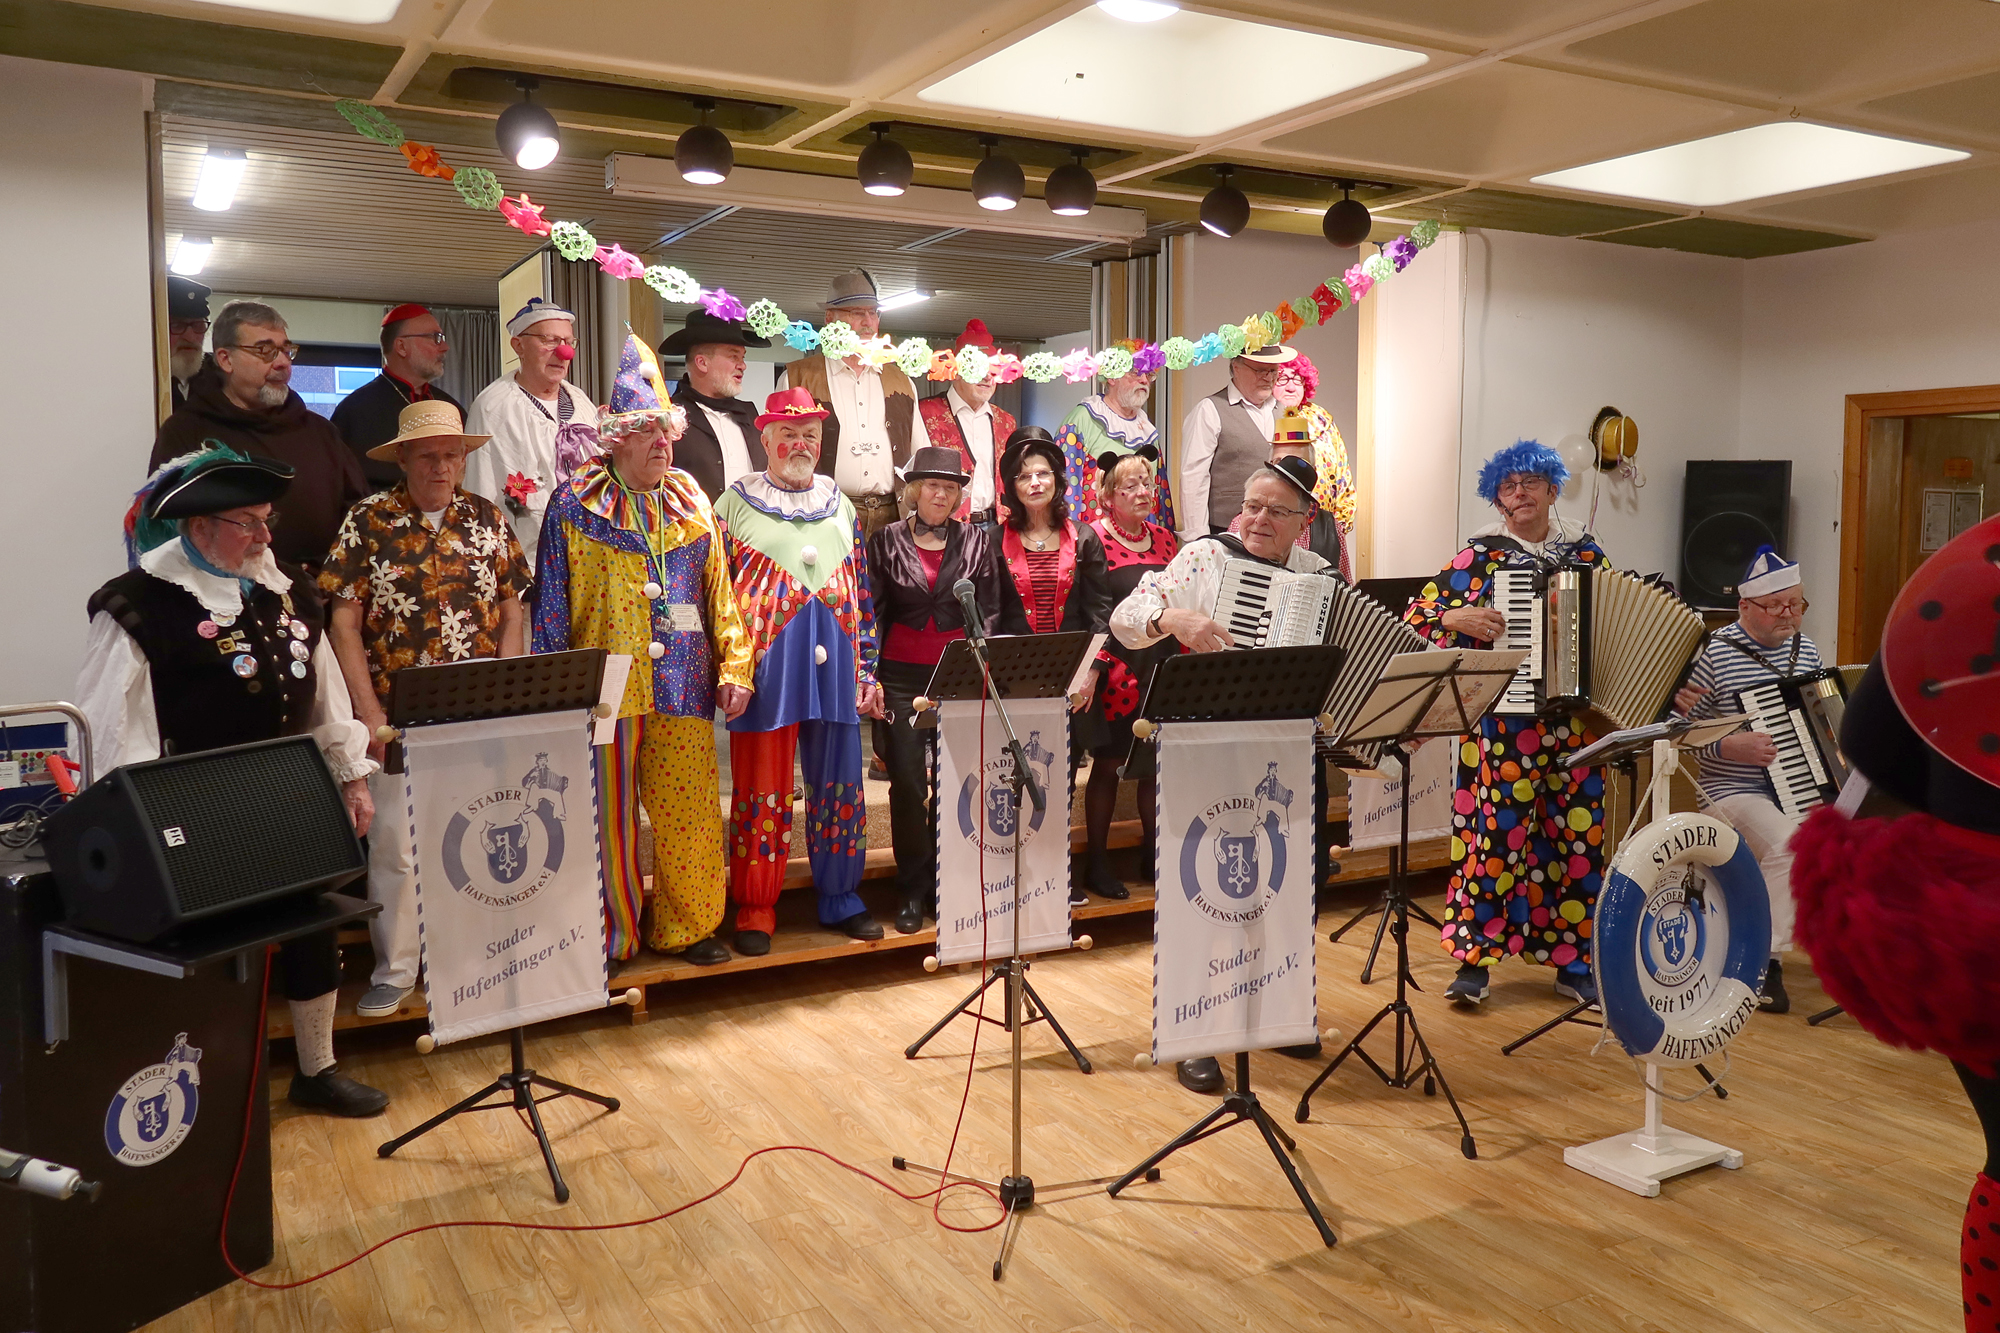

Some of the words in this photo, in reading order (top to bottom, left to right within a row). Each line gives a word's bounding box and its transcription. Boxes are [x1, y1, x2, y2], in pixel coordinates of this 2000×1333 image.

[1316, 595, 1329, 637] HOHNER
[978, 758, 1015, 776] STADE
[1363, 789, 1425, 826] Hafensäger
[1426, 776, 1441, 795] e.V.
[1383, 774, 1416, 795] Star
[466, 788, 522, 816] STADER
[1206, 797, 1256, 821] STADER
[1652, 825, 1719, 872] STADER
[463, 883, 539, 908] HAFENSÄNGER
[536, 870, 552, 889] e.V.
[983, 873, 1022, 897] Stade
[1034, 877, 1056, 898] e.V.
[1194, 894, 1265, 923] HAFENSÄNGER
[1263, 890, 1274, 908] e.V.
[1650, 890, 1684, 915] STADER
[1662, 917, 1682, 929] STADE
[485, 922, 536, 961] Stader
[451, 946, 555, 1008] Hafensänger
[557, 924, 586, 952] e.V.
[1207, 946, 1261, 979] Stader
[1173, 970, 1275, 1025] Hafensänger
[1276, 951, 1300, 979] e.V.
[1648, 994, 1675, 1014] seit
[1679, 973, 1710, 1012] 1977
[1660, 996, 1756, 1061] HAFENSÄNGER
[125, 1066, 167, 1093] STADER
